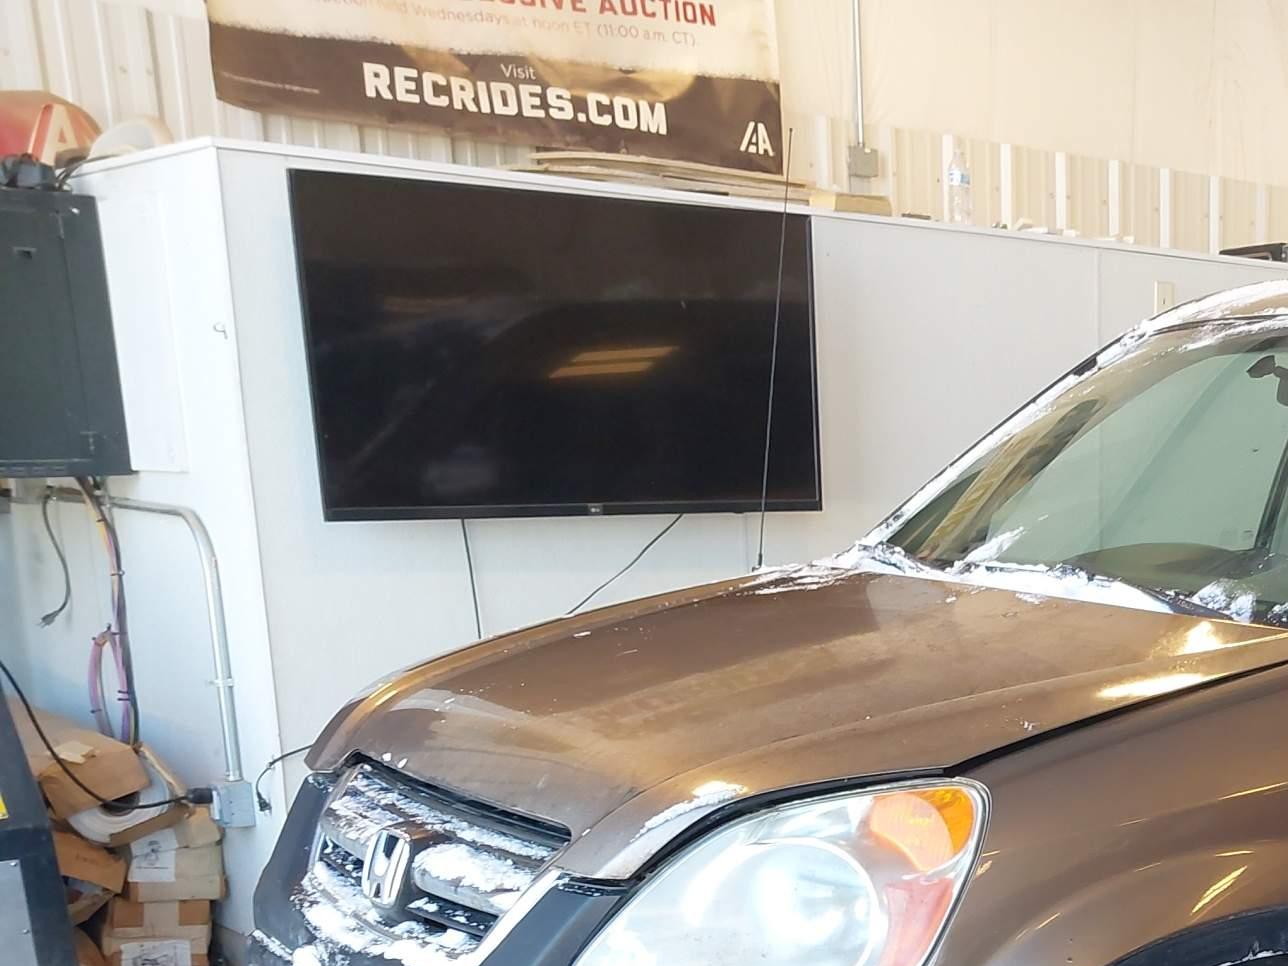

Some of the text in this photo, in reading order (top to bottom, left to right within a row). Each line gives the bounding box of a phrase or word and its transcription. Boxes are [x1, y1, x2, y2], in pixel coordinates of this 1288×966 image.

[414, 5, 509, 25] Wednesdays
[671, 31, 696, 47] CT)
[598, 0, 717, 26] AUCTION
[500, 63, 537, 80] Visit
[362, 62, 668, 135] RECRIDES.COM
